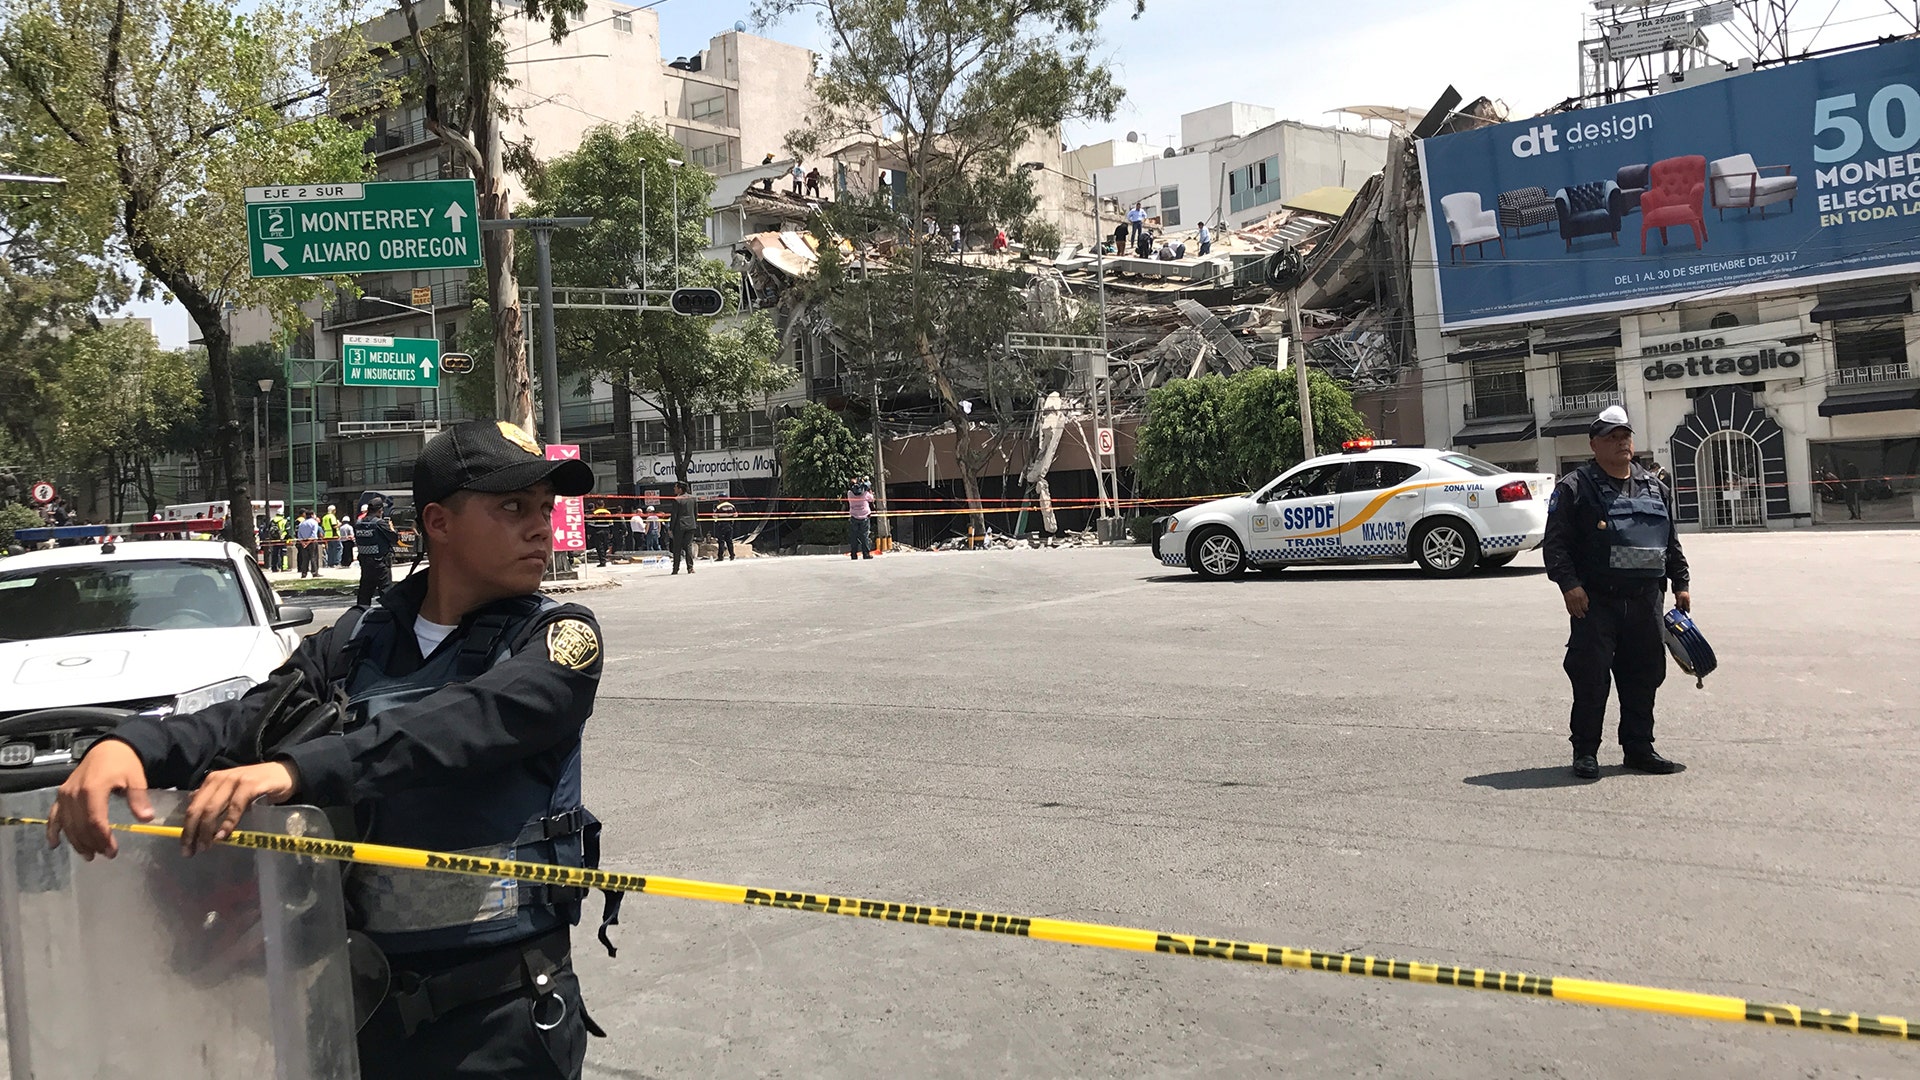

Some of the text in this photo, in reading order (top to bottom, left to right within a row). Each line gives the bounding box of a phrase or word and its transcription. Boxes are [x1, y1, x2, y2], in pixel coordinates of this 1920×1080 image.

[1637, 14, 1685, 28] PRA 25/2004
[1511, 113, 1654, 158] dt design
[1568, 138, 1619, 151] muebles
[264, 186, 344, 199] EJE 2 SUR
[268, 208, 434, 233] 2 MONTERREY
[1820, 212, 1843, 228] EN
[1848, 205, 1898, 223] TODA
[302, 236, 467, 263] ALVARO OBREGON
[1614, 250, 1798, 285] DEL 1 AL 30 DE SEPTIEMBRE DEL 2017
[1642, 336, 1725, 356] muebles
[353, 351, 416, 364] 3 MEDELLIN
[1643, 349, 1801, 381] dettaglio
[351, 368, 416, 381] AV INSURGENTES
[687, 457, 750, 477] Quiropráctico
[1443, 484, 1465, 492] ZONA
[565, 498, 584, 548] CENTRO
[1284, 505, 1335, 531] SSPDF
[1361, 521, 1407, 542] MX-019-T3
[1285, 537, 1341, 548] TRANSI
